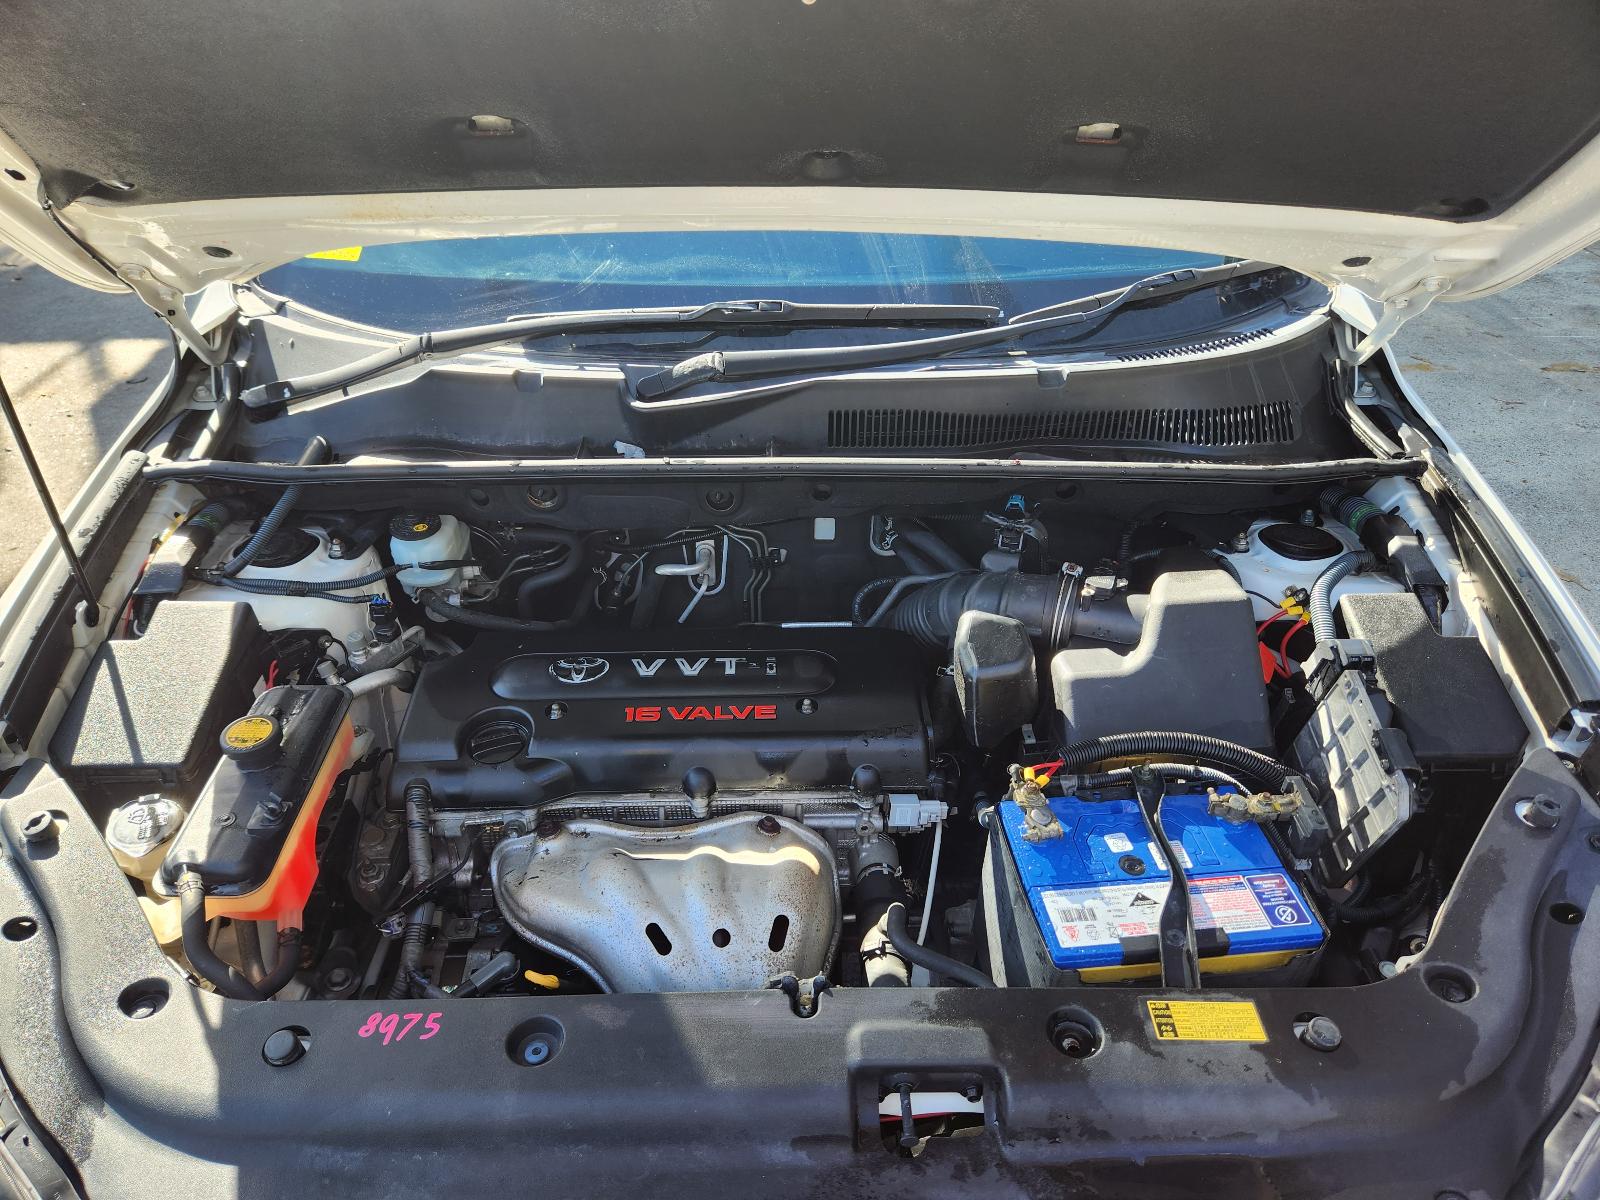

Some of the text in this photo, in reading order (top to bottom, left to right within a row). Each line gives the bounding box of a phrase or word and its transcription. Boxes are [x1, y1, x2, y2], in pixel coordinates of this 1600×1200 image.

[625, 705, 777, 722] 16 VALVE
[358, 1012, 442, 1045] 8975
